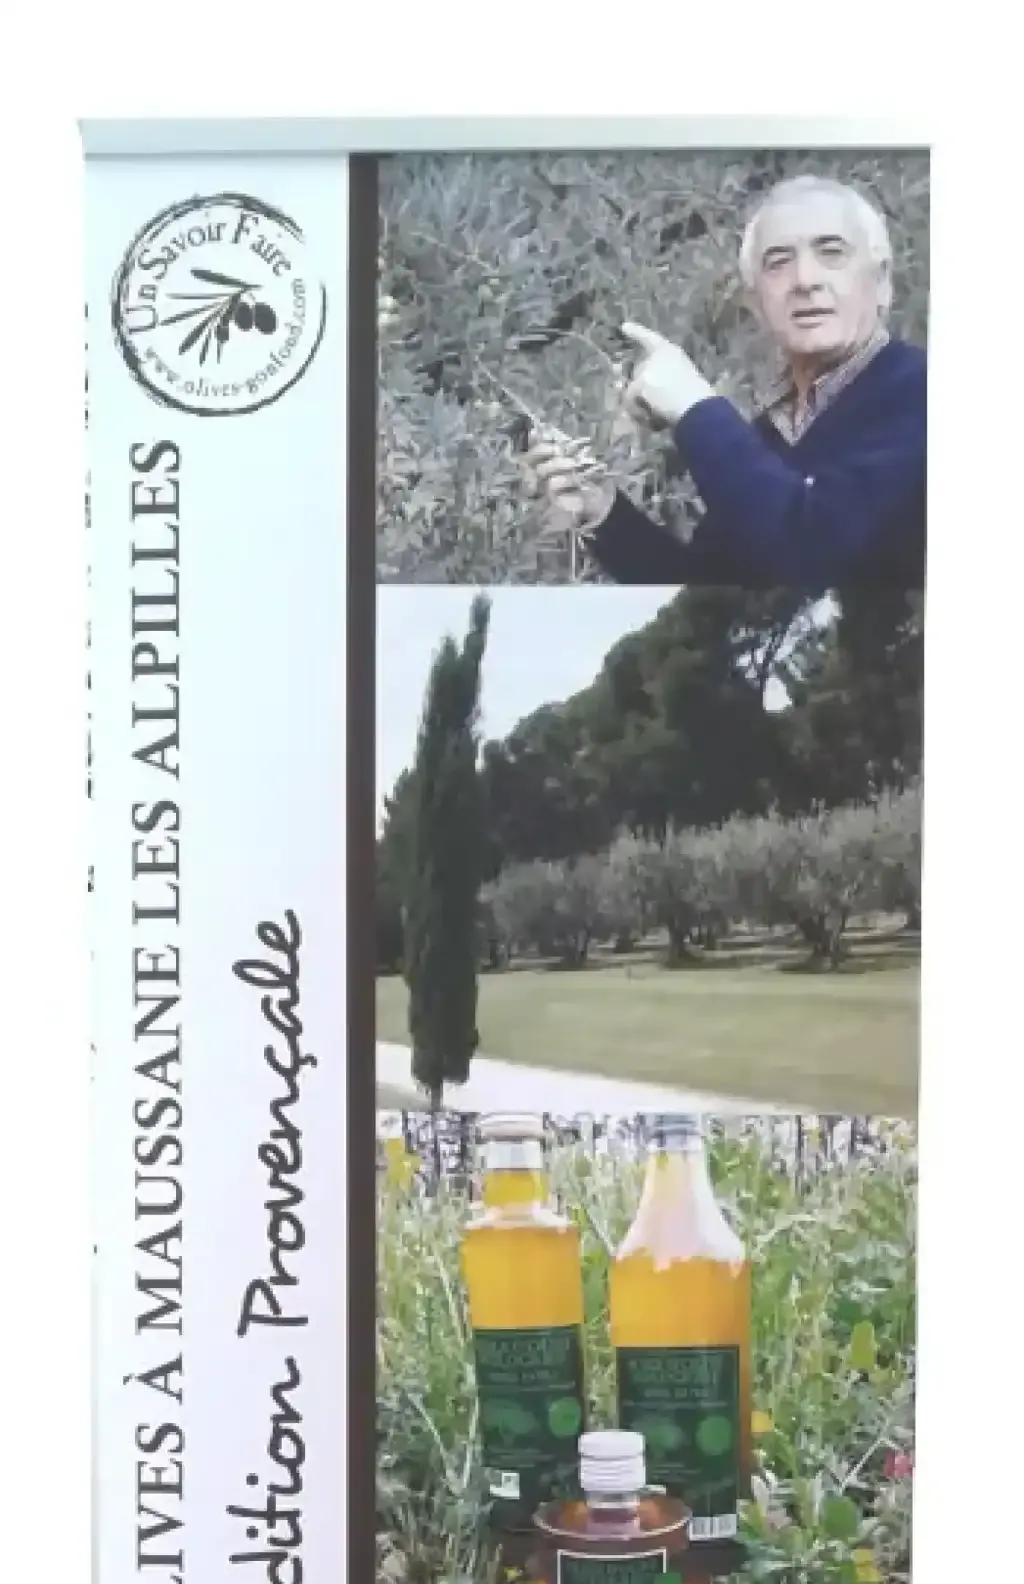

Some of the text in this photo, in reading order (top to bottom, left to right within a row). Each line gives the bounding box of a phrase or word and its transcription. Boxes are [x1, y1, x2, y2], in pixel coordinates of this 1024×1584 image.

[126, 209, 292, 335] Un Savoir Faire
[130, 439, 181, 778] ALPILLES
[131, 800, 180, 922] LES
[134, 996, 183, 1332] MAUSSANE
[232, 909, 317, 1336] Provençale
[123, 1357, 183, 1401] À
